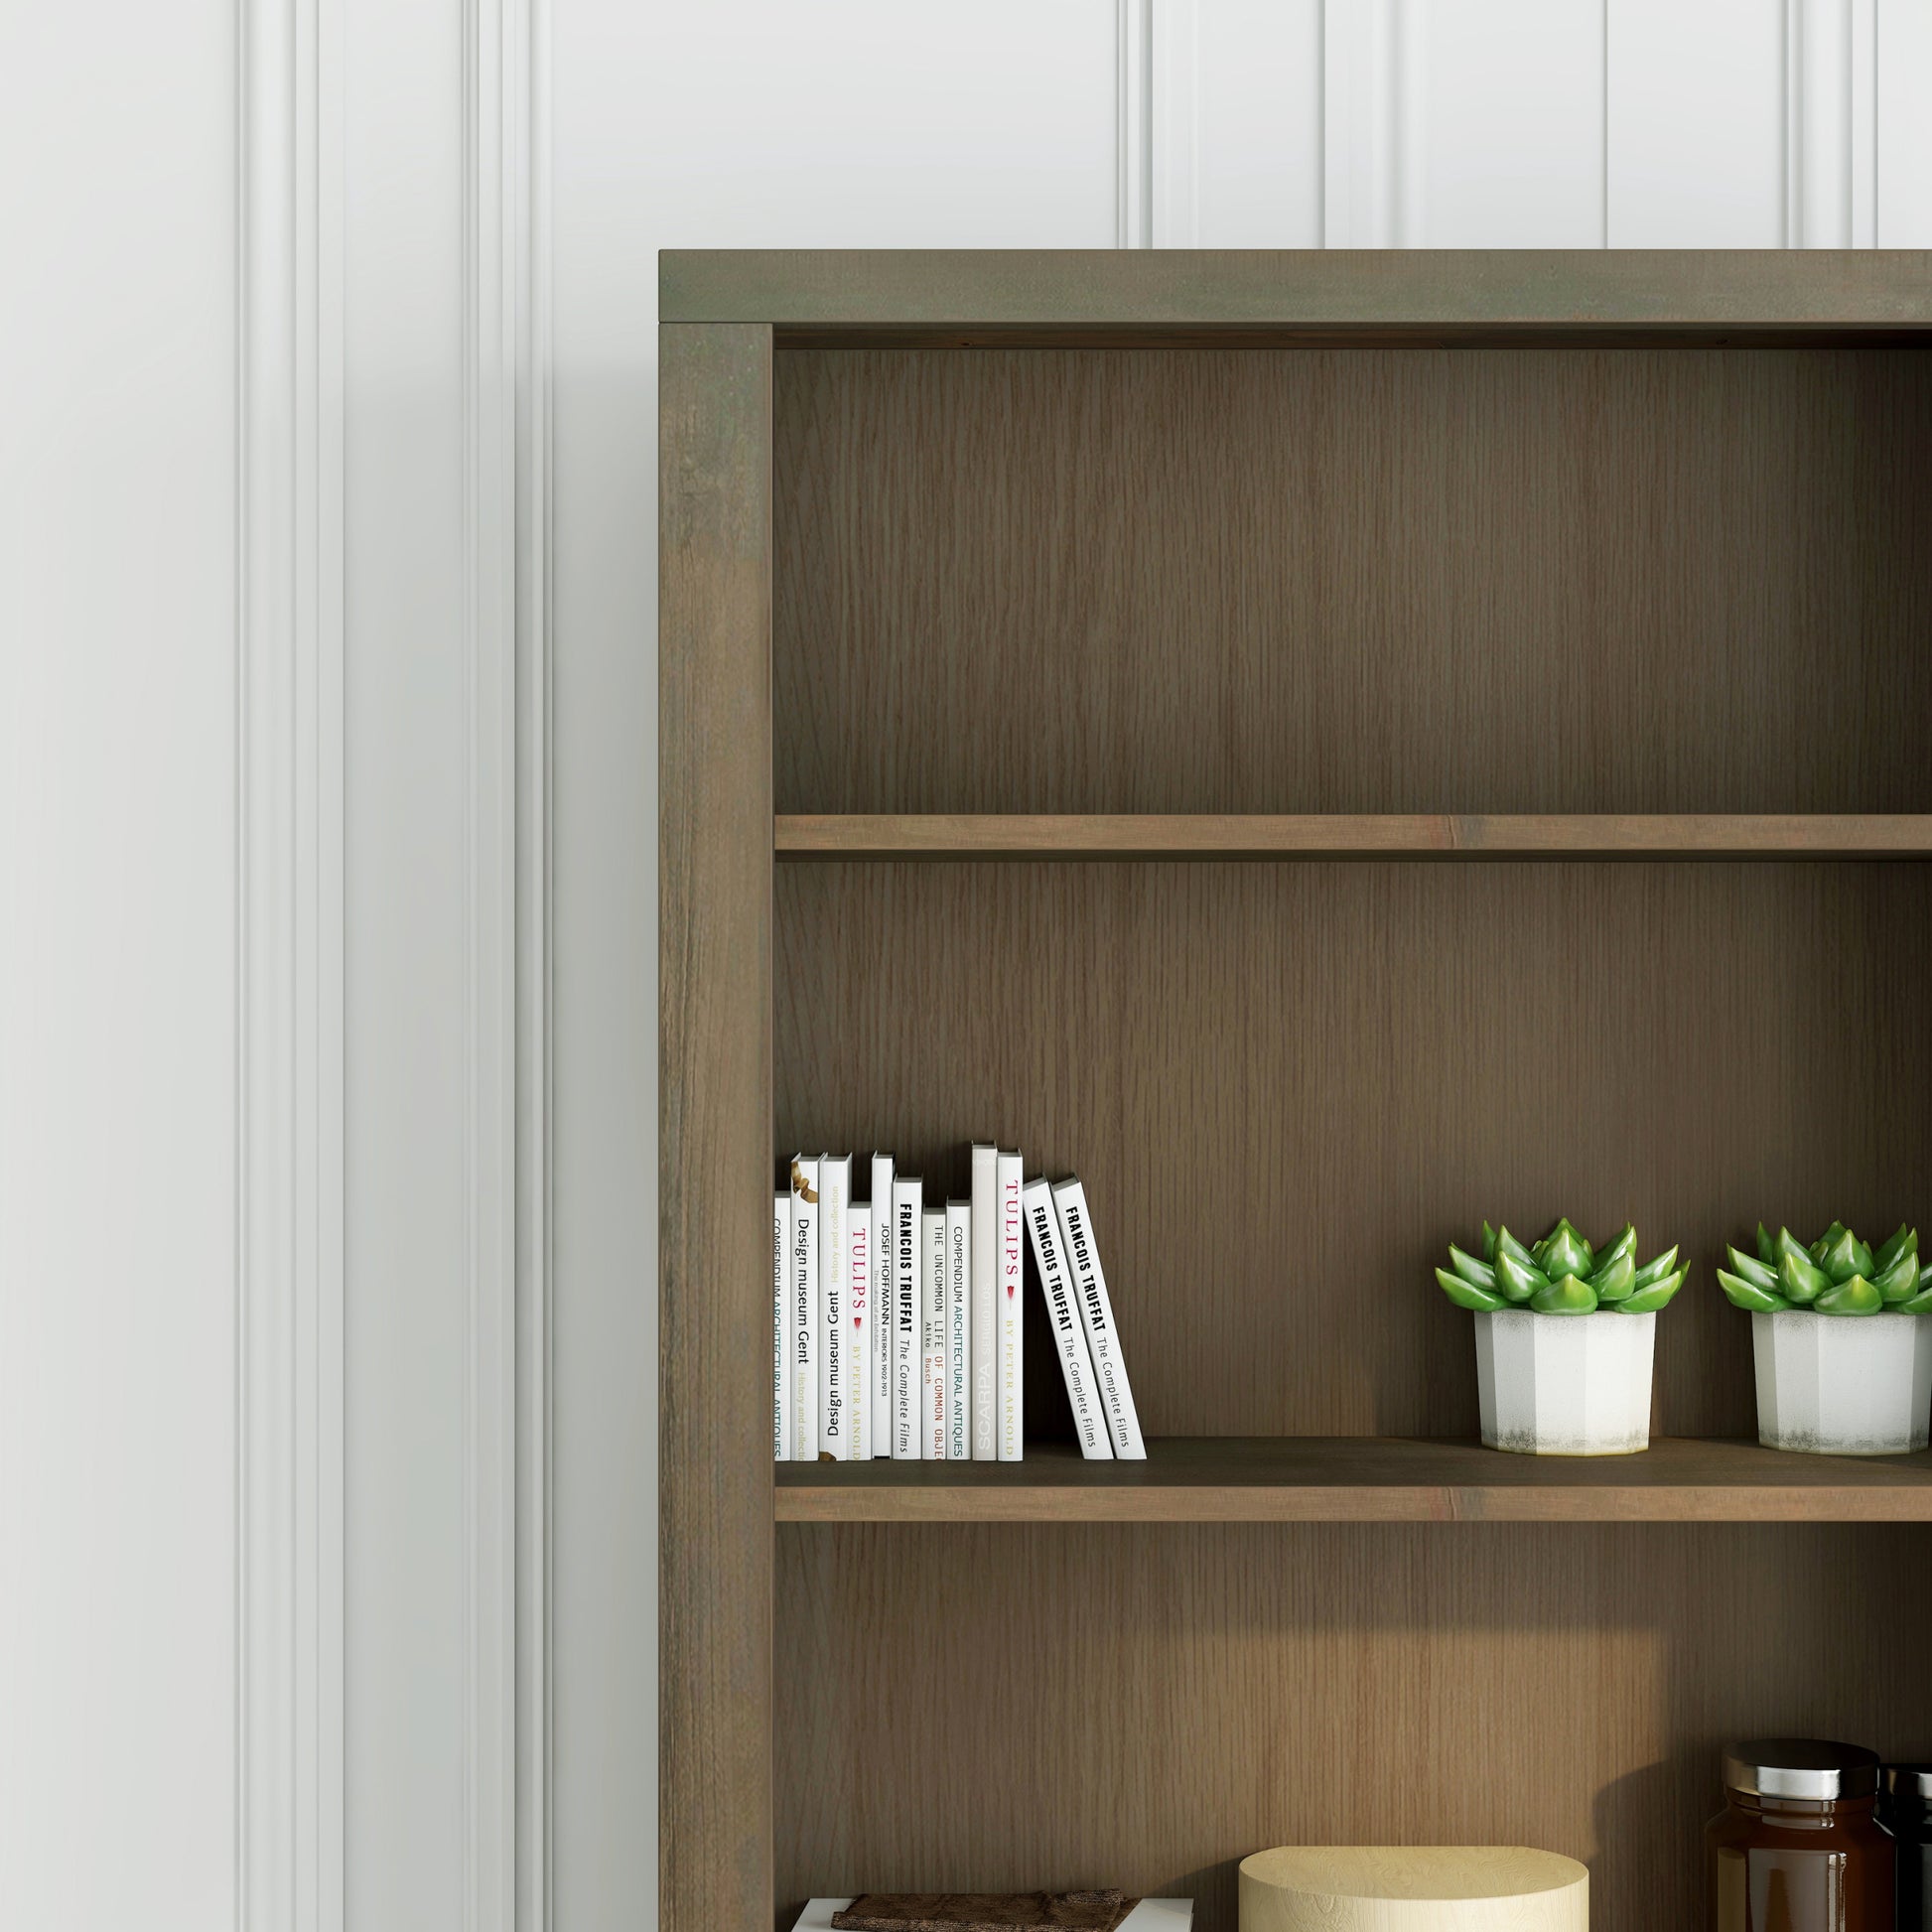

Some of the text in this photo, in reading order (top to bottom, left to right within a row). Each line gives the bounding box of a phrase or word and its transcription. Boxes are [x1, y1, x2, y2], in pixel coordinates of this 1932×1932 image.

[795, 1219, 809, 1265] Design
[881, 1223, 890, 1256] JOSEF
[1006, 1179, 1018, 1276] TULIPS
[831, 1251, 841, 1283] History
[852, 1227, 866, 1309] TULIPS
[881, 1259, 890, 1325] HOFFMANN
[798, 1269, 807, 1326] museum
[828, 1291, 839, 1324] Gent
[798, 1330, 809, 1364] Gent
[853, 1346, 861, 1360] BY
[898, 1203, 911, 1452] FRANCOIS TRUFFAT The Complete Films
[934, 1225, 943, 1461] THE UNCOMMON LIFE OF COMMON OBJE
[952, 1226, 963, 1457] COMPENDIUM ARCHITECTURAL ANTIQUES
[1006, 1320, 1014, 1337] BY
[1033, 1206, 1096, 1448] FRANCOIS TRUFFAT The Complete Films
[1065, 1206, 1130, 1448] FRANCOIS TRUFFAT The Complete Films
[830, 1329, 839, 1386] museum
[796, 1372, 806, 1405] History
[828, 1390, 842, 1437] Design
[978, 1362, 991, 1450] SCARPA
